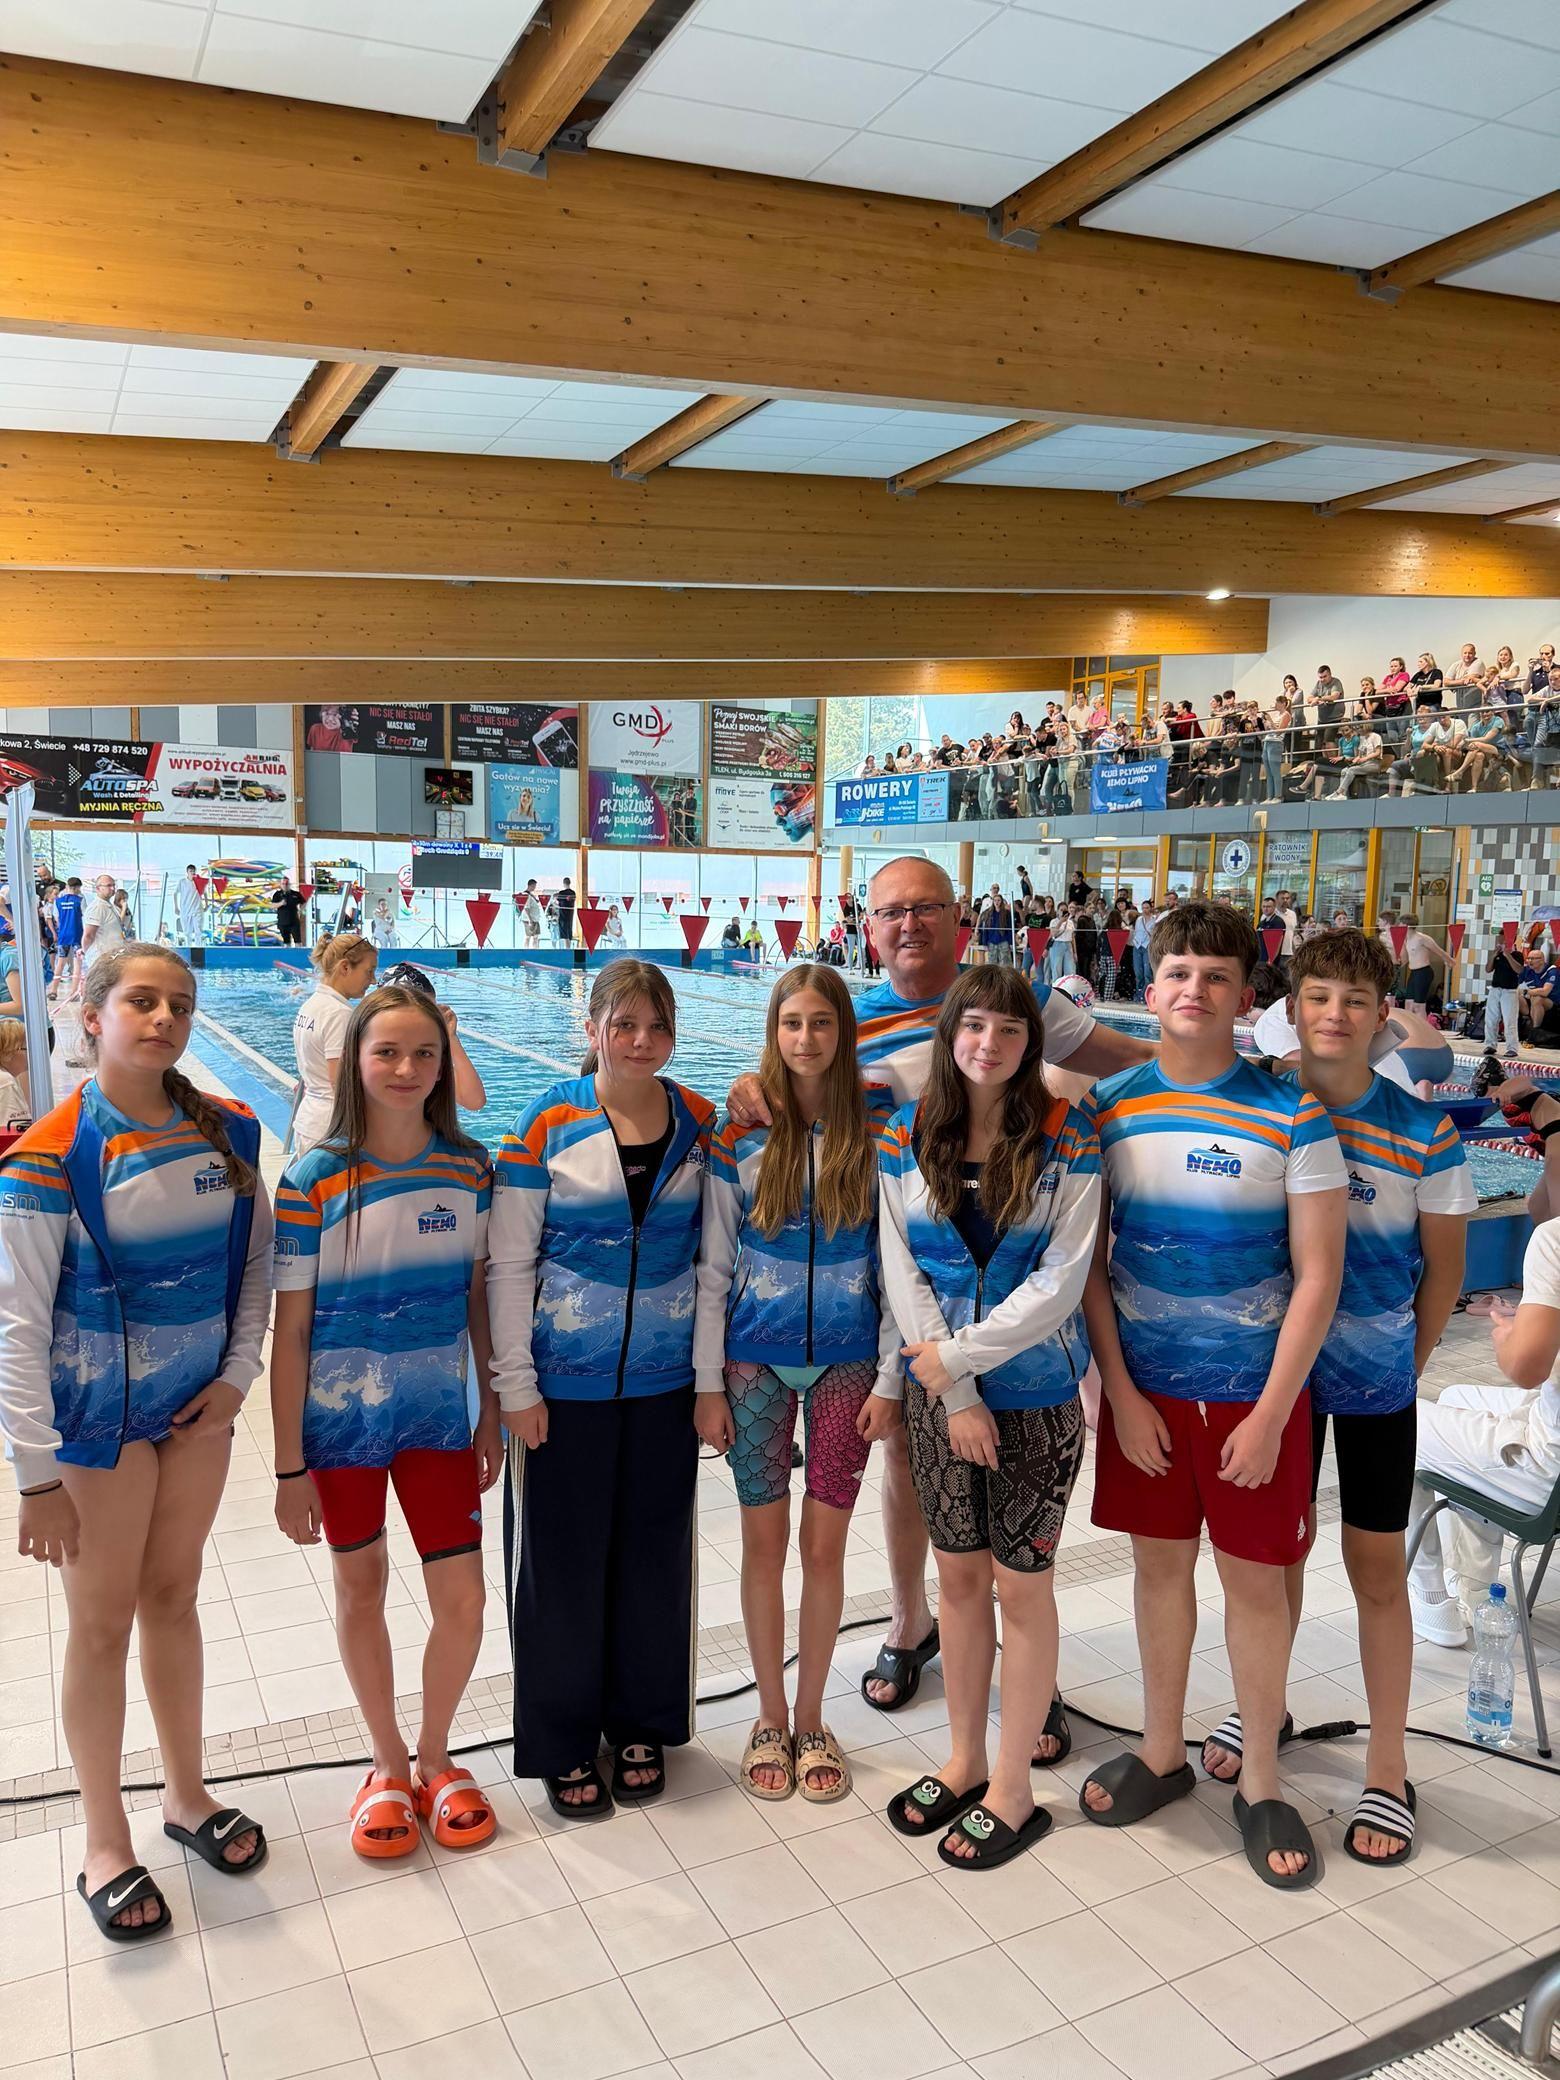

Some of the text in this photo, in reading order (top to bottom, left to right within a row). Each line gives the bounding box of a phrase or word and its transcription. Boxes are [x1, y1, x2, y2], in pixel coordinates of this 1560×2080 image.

[369, 707, 433, 722] NIC SIĘ NIE STAŁO!
[458, 714, 472, 723] NIC
[484, 716, 496, 726] NIE
[613, 712, 659, 729] GMD
[738, 713, 776, 723] SWOJSKIE
[387, 721, 416, 731] MASZ NAS
[476, 727, 504, 736] MASZ NAS
[713, 722, 767, 733] SMAKI BORÓW
[0, 739, 22, 748] kowa
[34, 739, 67, 751] Świecie
[73, 743, 90, 752] +48
[93, 744, 109, 754] 729
[112, 745, 129, 754] 874
[131, 747, 148, 755] 520
[388, 735, 428, 748] RedTel
[169, 757, 288, 776] WYPOŻYCZALNIA
[1119, 764, 1157, 777] PŁYWACKI
[491, 771, 520, 780] Gotów
[536, 777, 559, 785] nowe
[1127, 775, 1149, 785] LIPNO
[80, 780, 159, 791] AUTOSPA
[503, 783, 551, 794] wyzwnia?
[841, 779, 913, 802] ROWERY
[79, 802, 119, 811] MYJNIA
[121, 802, 164, 813] RĘCZNA
[600, 795, 655, 813] PRZYSZŁOŚĆ
[597, 815, 611, 824] na
[1187, 1153, 1242, 1175] NEMO
[193, 1171, 230, 1192] NEM
[418, 1214, 457, 1231] NEMO
